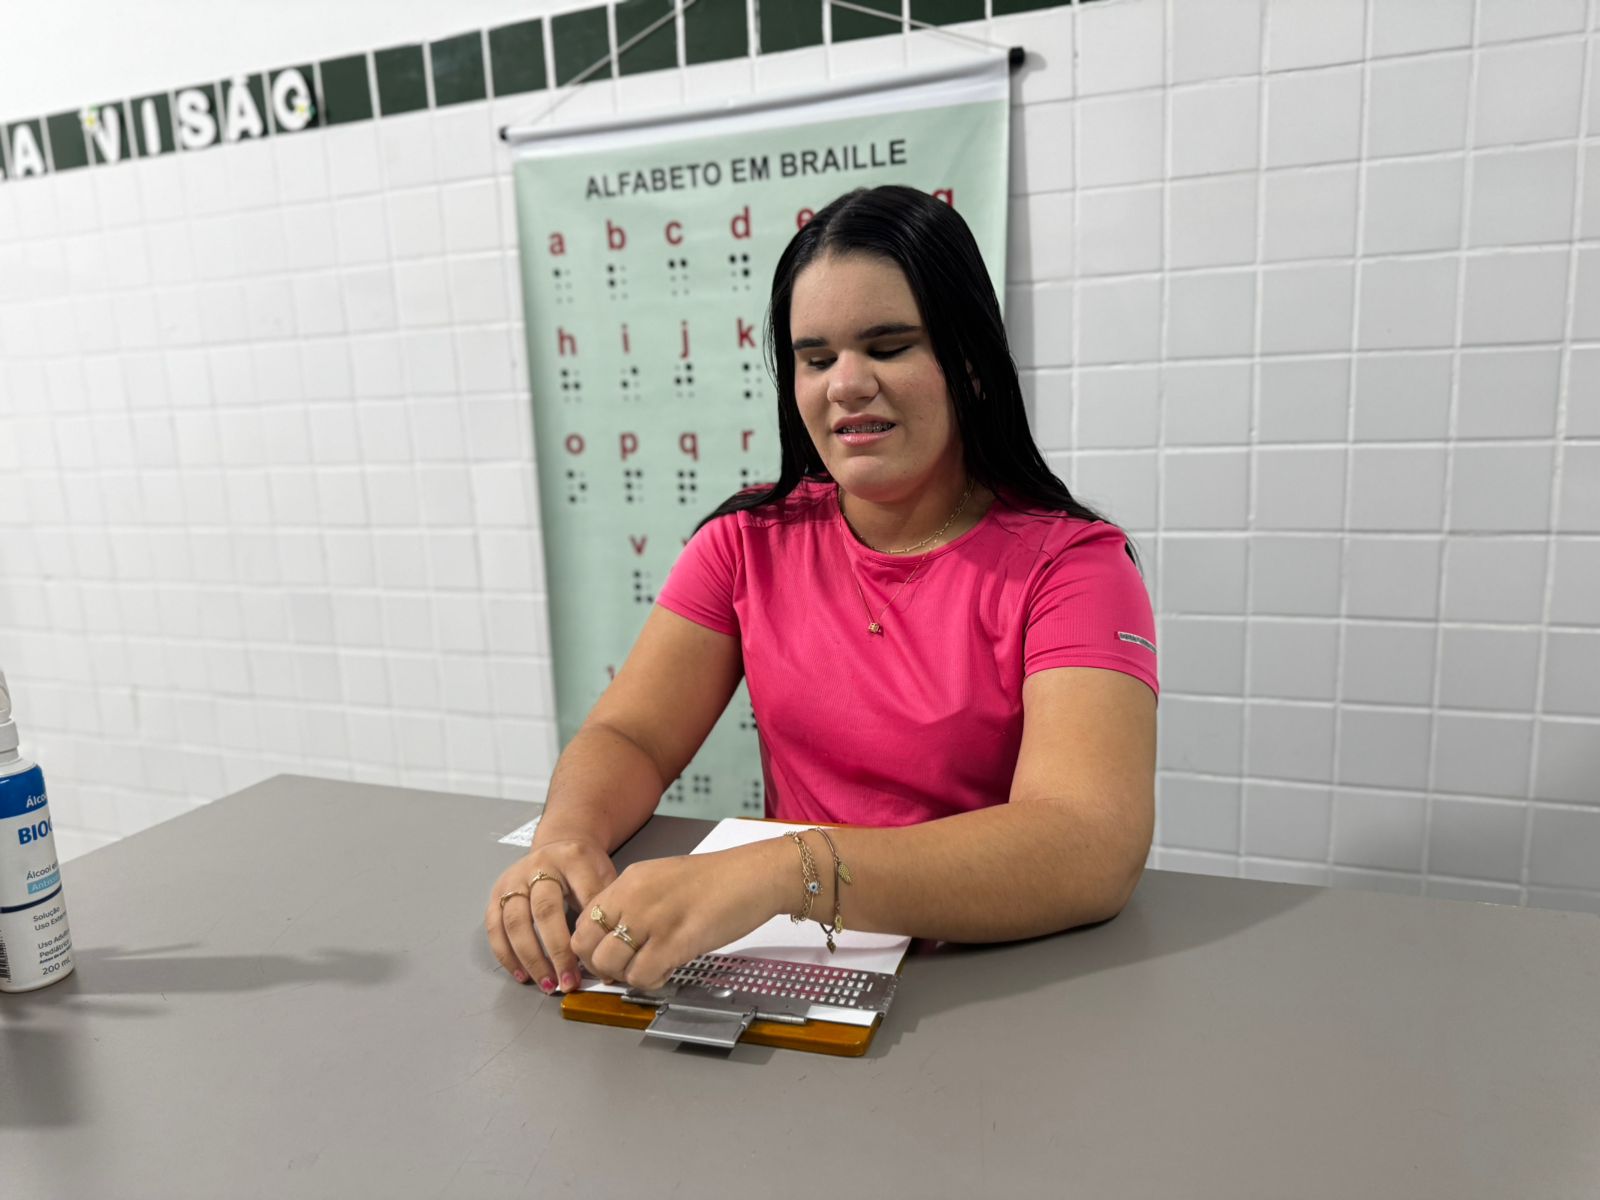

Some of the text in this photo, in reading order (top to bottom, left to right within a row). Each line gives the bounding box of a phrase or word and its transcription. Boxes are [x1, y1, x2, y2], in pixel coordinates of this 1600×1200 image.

[0, 124, 45, 180] A
[586, 139, 907, 199] ALFABETO EM BRAILLE
[549, 231, 565, 256] a
[606, 218, 627, 251] b
[665, 220, 684, 246] c
[730, 205, 750, 240] d
[557, 316, 757, 360] h i j k
[565, 429, 755, 462] o p q r
[629, 535, 648, 557] v
[35, 922, 50, 931] Uso
[38, 940, 53, 949] Uso
[42, 962, 60, 976] 200
